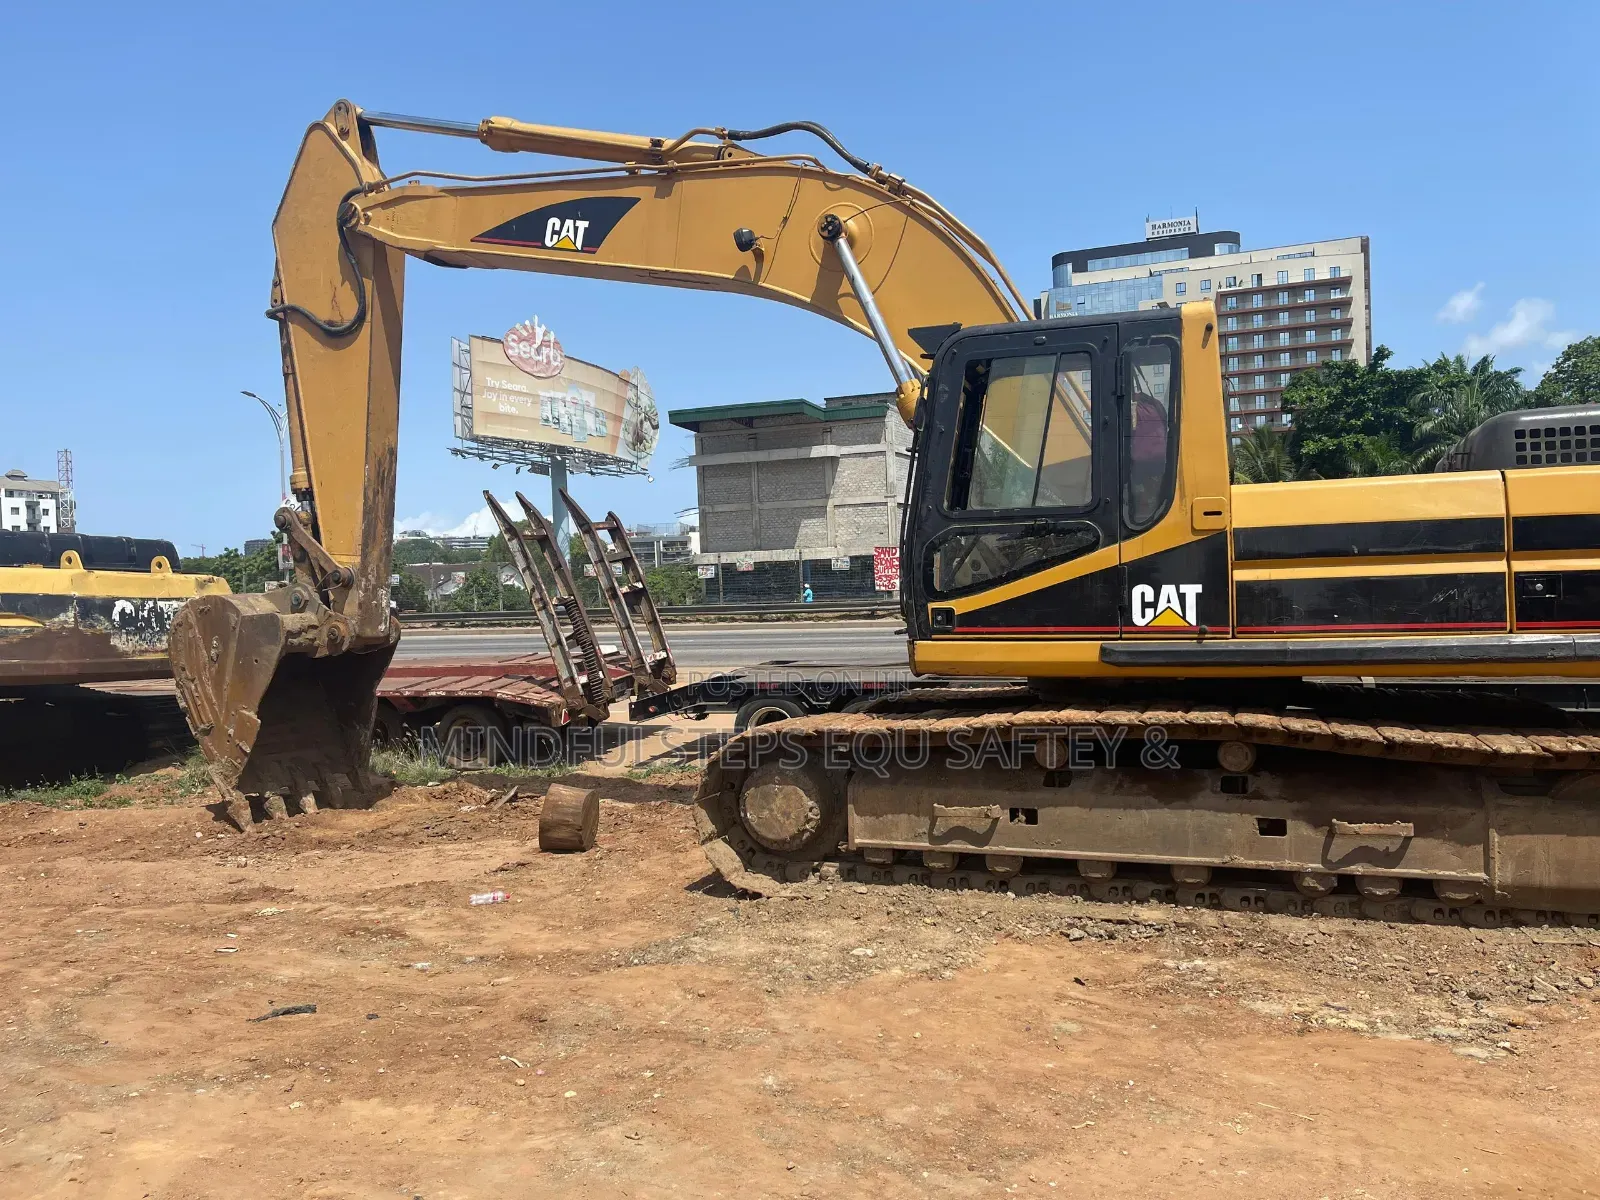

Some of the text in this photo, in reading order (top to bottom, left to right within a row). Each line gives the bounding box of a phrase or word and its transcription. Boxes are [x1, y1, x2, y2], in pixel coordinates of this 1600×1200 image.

[1151, 220, 1191, 230] HARMONIA
[1151, 226, 1191, 236] RESIDENCE
[544, 217, 589, 251] CAT
[485, 376, 529, 392] Try Seara.
[482, 389, 533, 407] Joy in every
[499, 402, 519, 414] bite.
[874, 547, 898, 558] SAND
[1131, 583, 1203, 627] CAT
